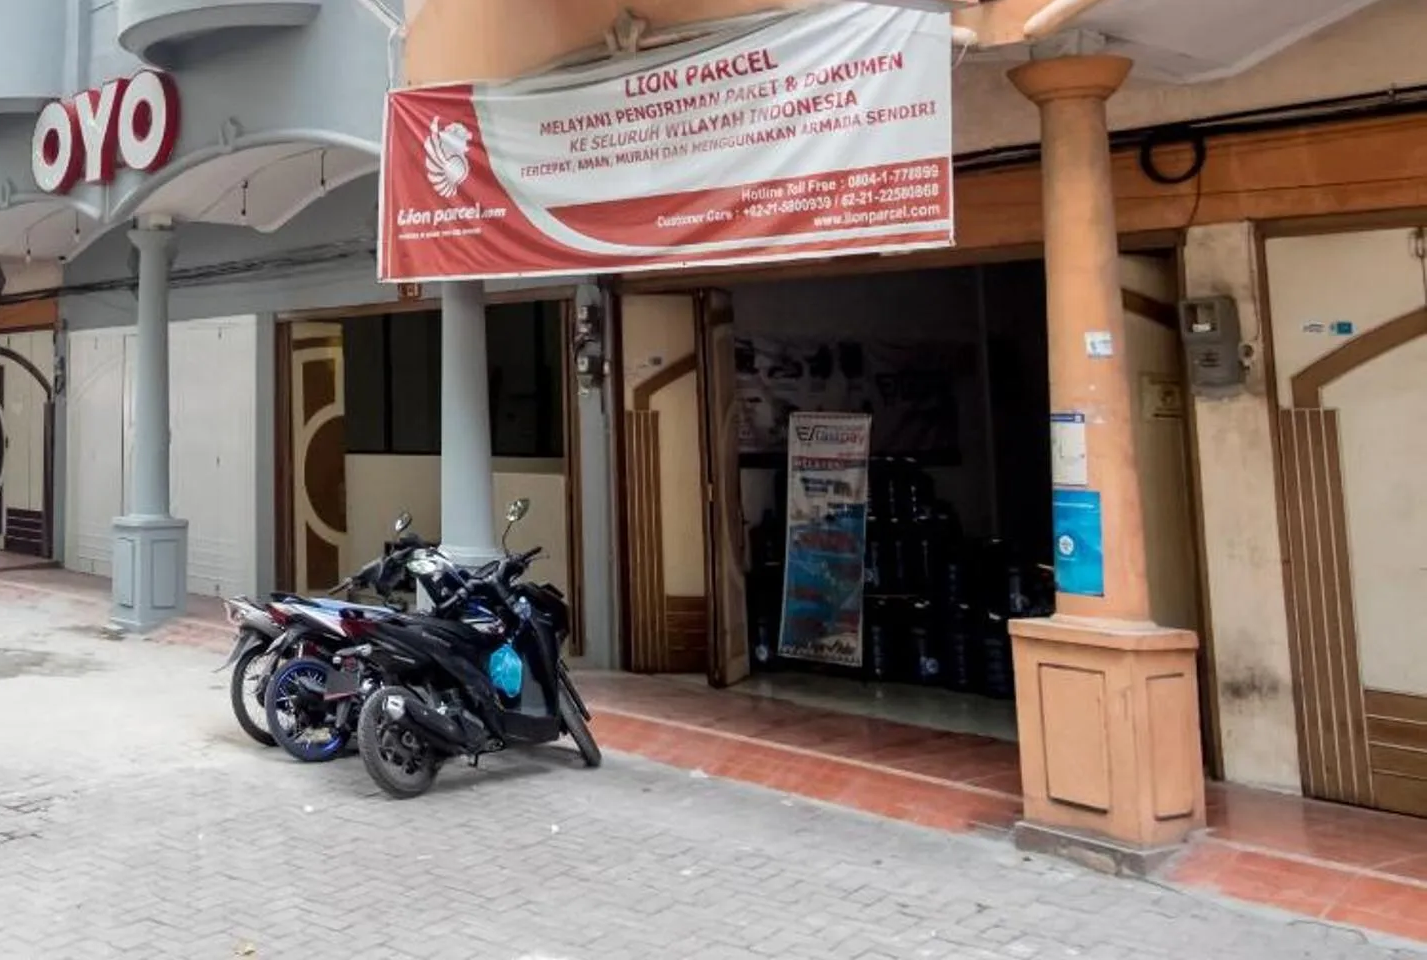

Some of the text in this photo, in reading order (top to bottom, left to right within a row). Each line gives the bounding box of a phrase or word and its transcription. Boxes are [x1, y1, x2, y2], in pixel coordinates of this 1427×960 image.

[539, 51, 904, 136] MELAYANI PENGIRIMAN PAKET & DOKUMEN
[625, 48, 779, 98] LION PARCEL
[31, 70, 175, 194] OYO
[569, 89, 859, 154] KE SELURUH WILAYAH INDONESIA
[615, 147, 659, 165] MURAH
[662, 144, 689, 160] DAN
[691, 126, 797, 155] MENGGUNAKAN
[801, 115, 862, 136] ARMADA
[866, 100, 937, 126] SENDIRI
[397, 201, 507, 226] Lion parcel.com
[741, 185, 784, 202] Hotline
[807, 179, 836, 192] Free
[813, 203, 940, 228] www.lionparcel.com
